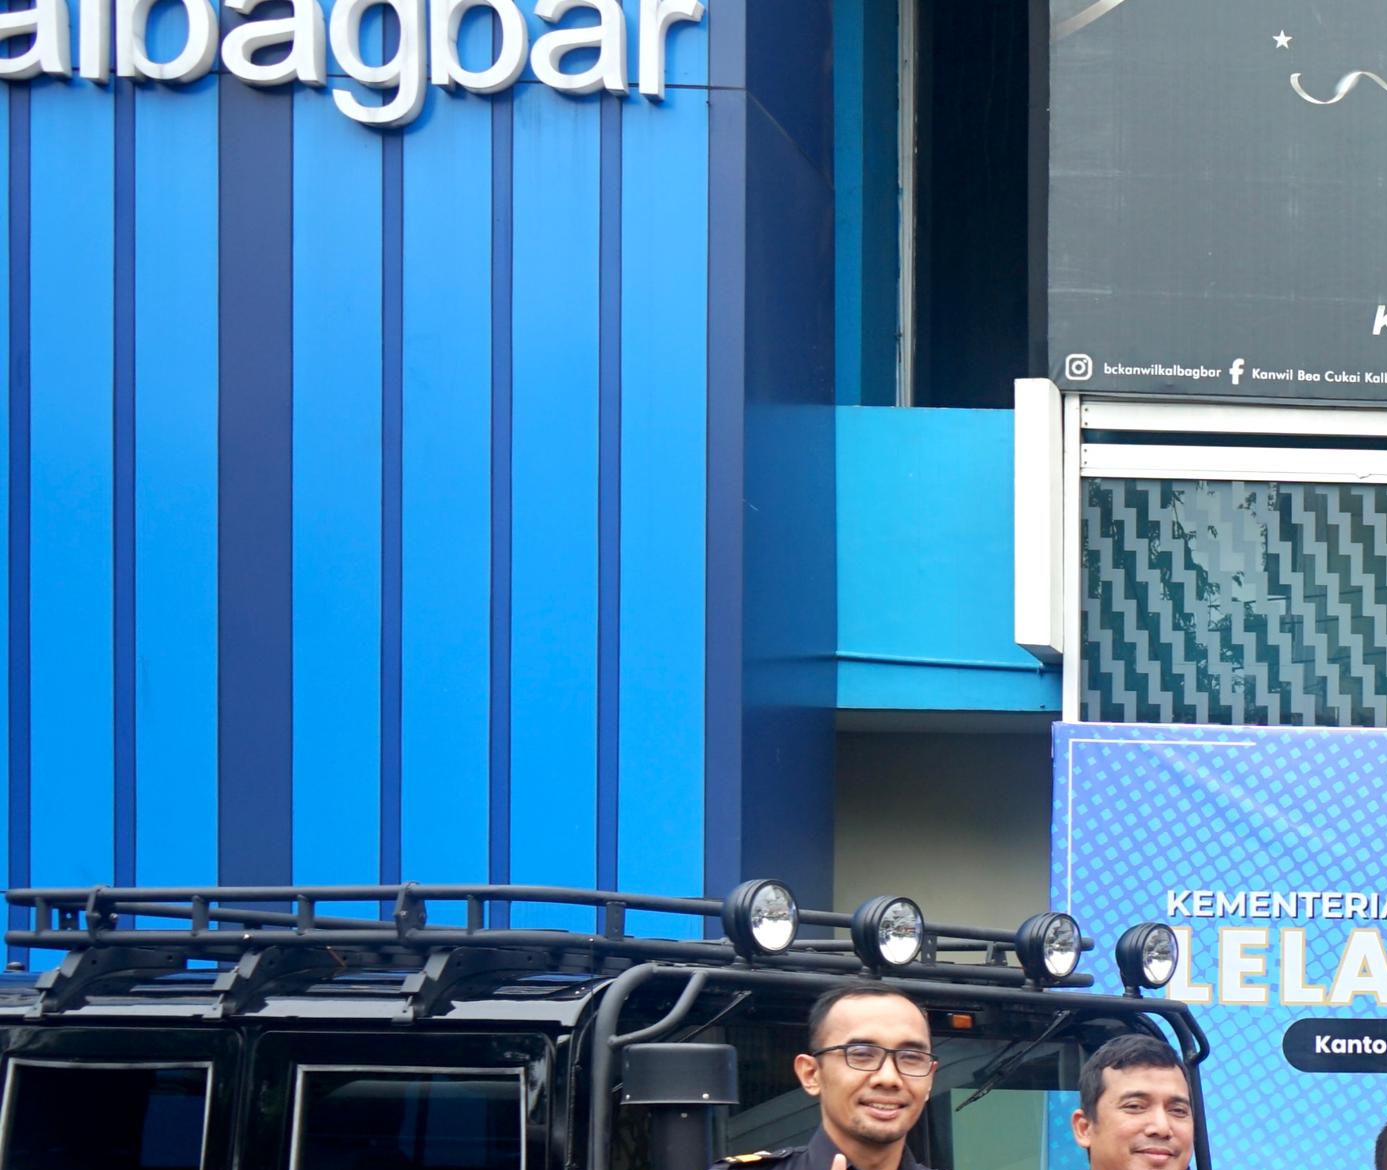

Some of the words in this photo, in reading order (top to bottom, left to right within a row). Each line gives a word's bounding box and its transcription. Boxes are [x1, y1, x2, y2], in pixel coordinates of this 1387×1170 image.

[1103, 362, 1222, 380] bckanwilkalbagbar
[1252, 367, 1294, 382] Kanwil
[1298, 369, 1321, 383] Bea
[1325, 370, 1362, 385] Cukai
